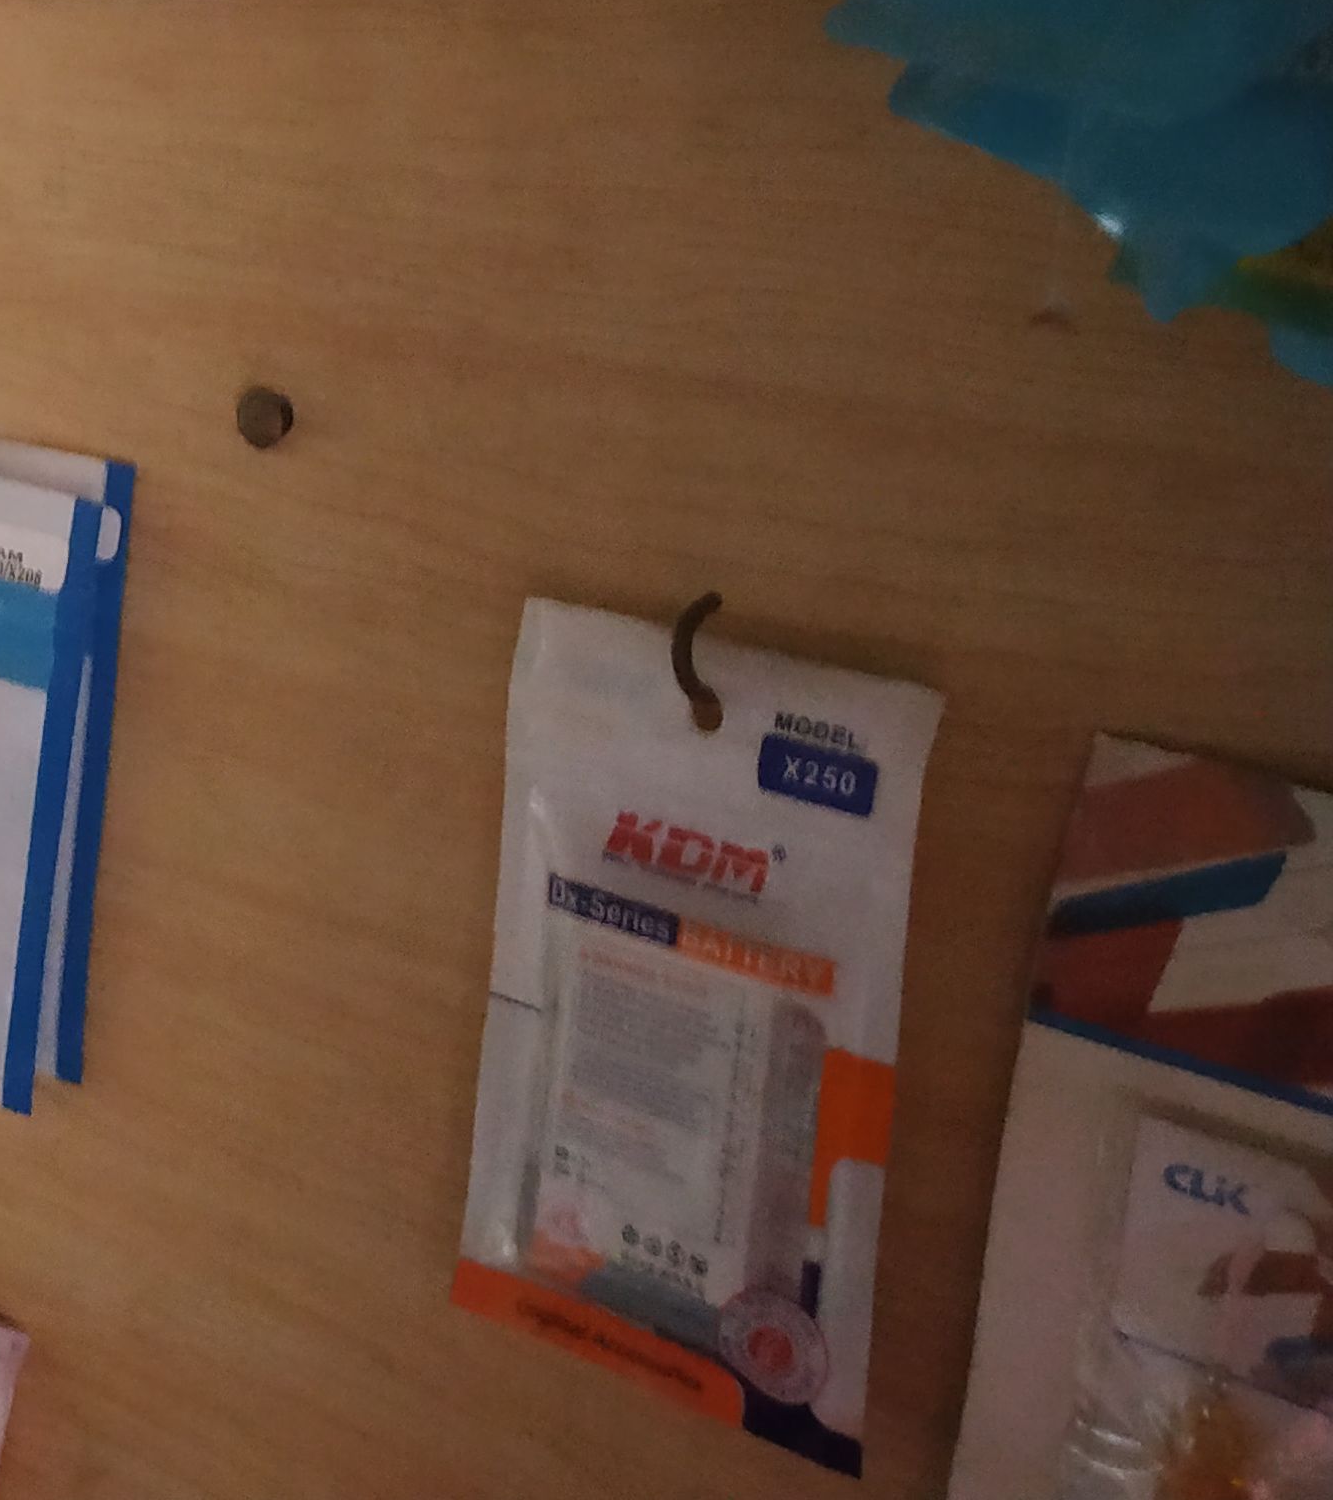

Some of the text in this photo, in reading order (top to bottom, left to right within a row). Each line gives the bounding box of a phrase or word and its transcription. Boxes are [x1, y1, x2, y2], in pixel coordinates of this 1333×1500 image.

[774, 711, 858, 750] MODEL
[782, 754, 858, 796] X250
[606, 810, 771, 894] KDM
